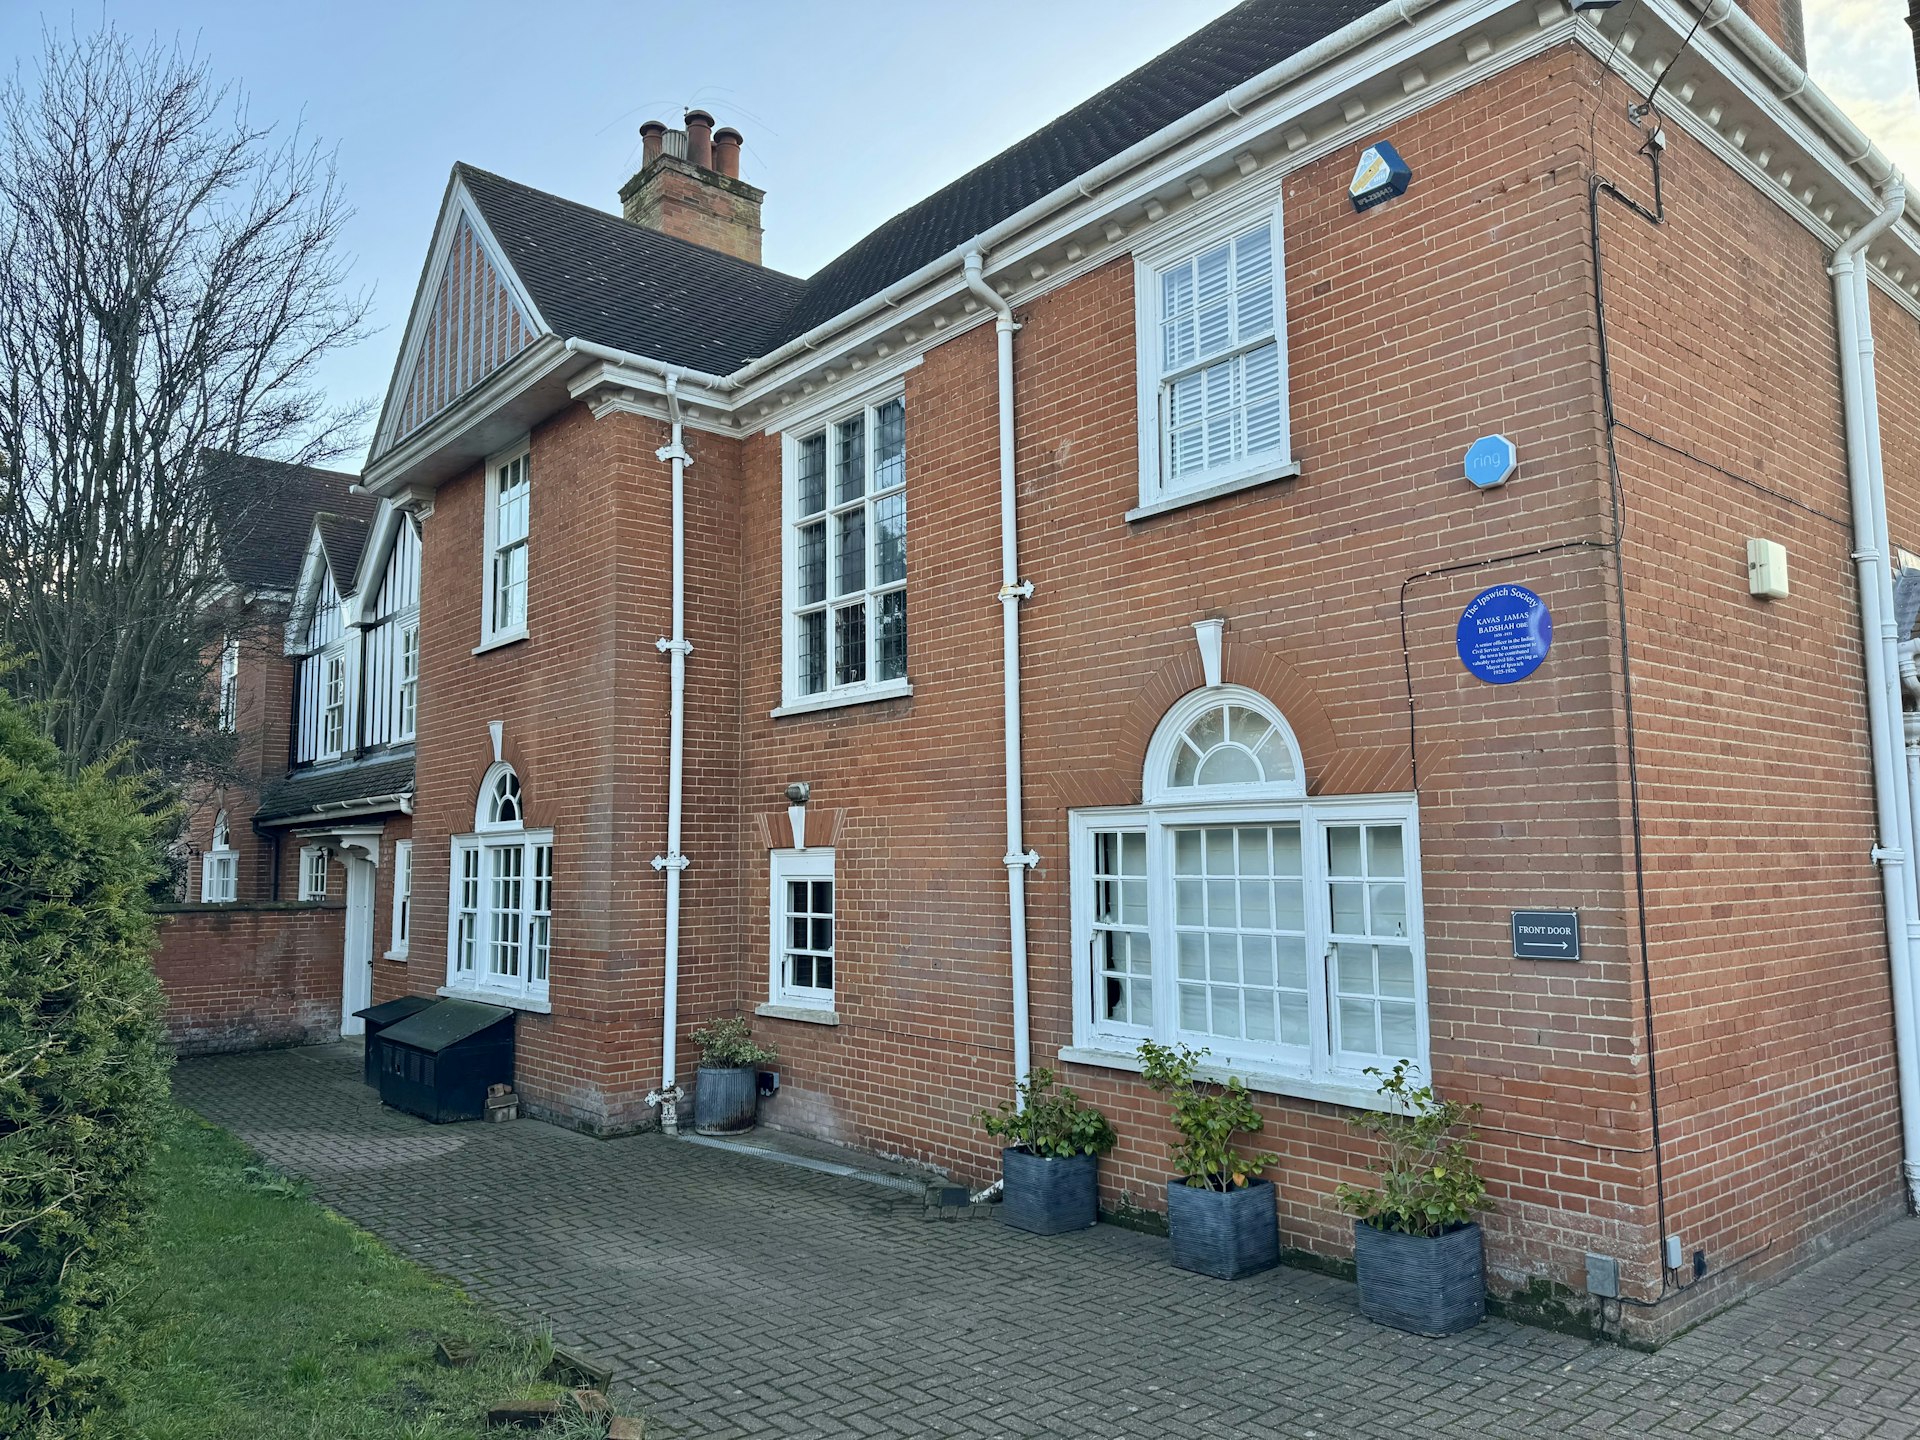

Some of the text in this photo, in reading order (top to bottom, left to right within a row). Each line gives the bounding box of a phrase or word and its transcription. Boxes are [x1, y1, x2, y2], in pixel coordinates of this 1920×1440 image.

[1474, 453, 1500, 469] ring
[1464, 588, 1538, 619] The Ipswich Society
[1476, 612, 1529, 626] KAVAS JAMAS
[1478, 622, 1514, 634] BADSHAH
[1505, 648, 1529, 656] contributed
[1518, 926, 1572, 935] FRONT DOOR
